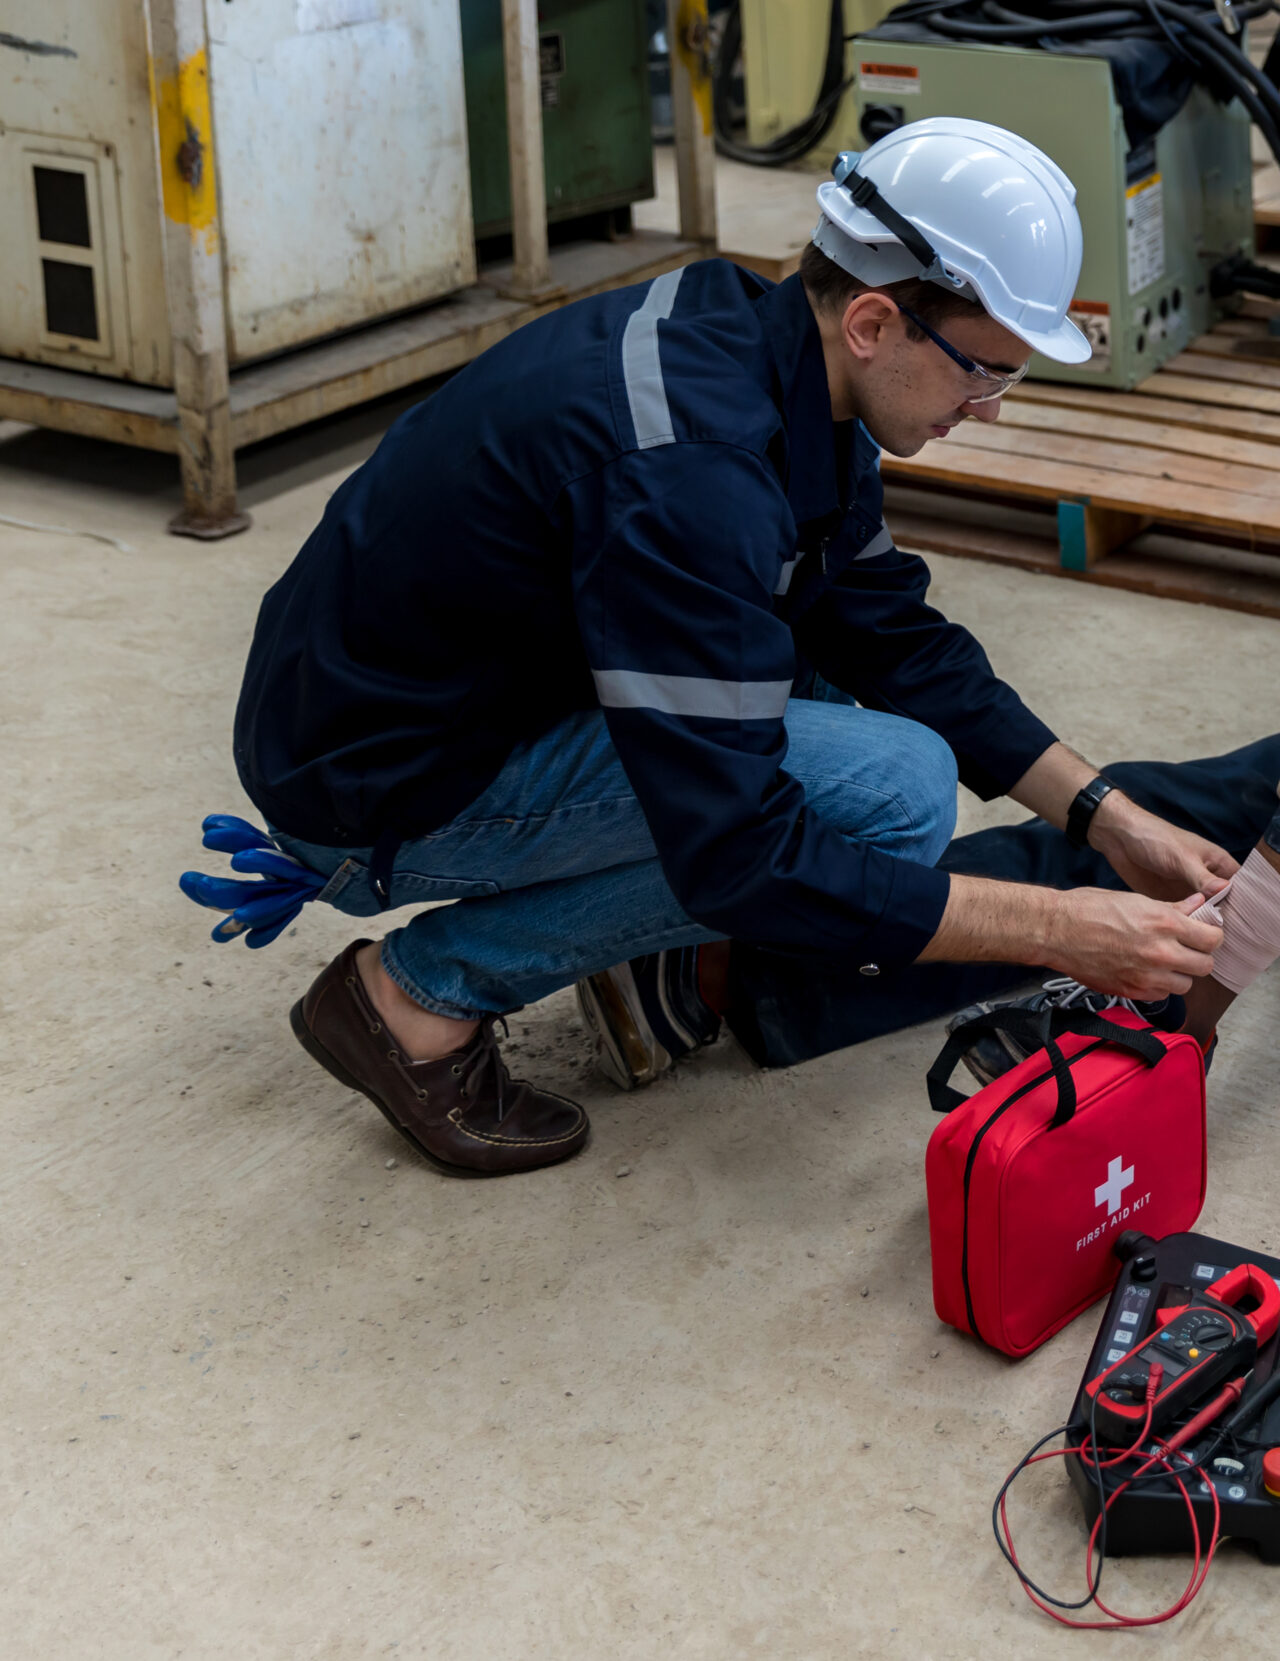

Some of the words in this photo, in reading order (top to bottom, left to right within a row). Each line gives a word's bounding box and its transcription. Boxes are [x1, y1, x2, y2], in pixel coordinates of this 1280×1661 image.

[1076, 1222, 1107, 1251] FIRST
[1111, 1207, 1130, 1227] AID
[1133, 1192, 1151, 1212] KIT
